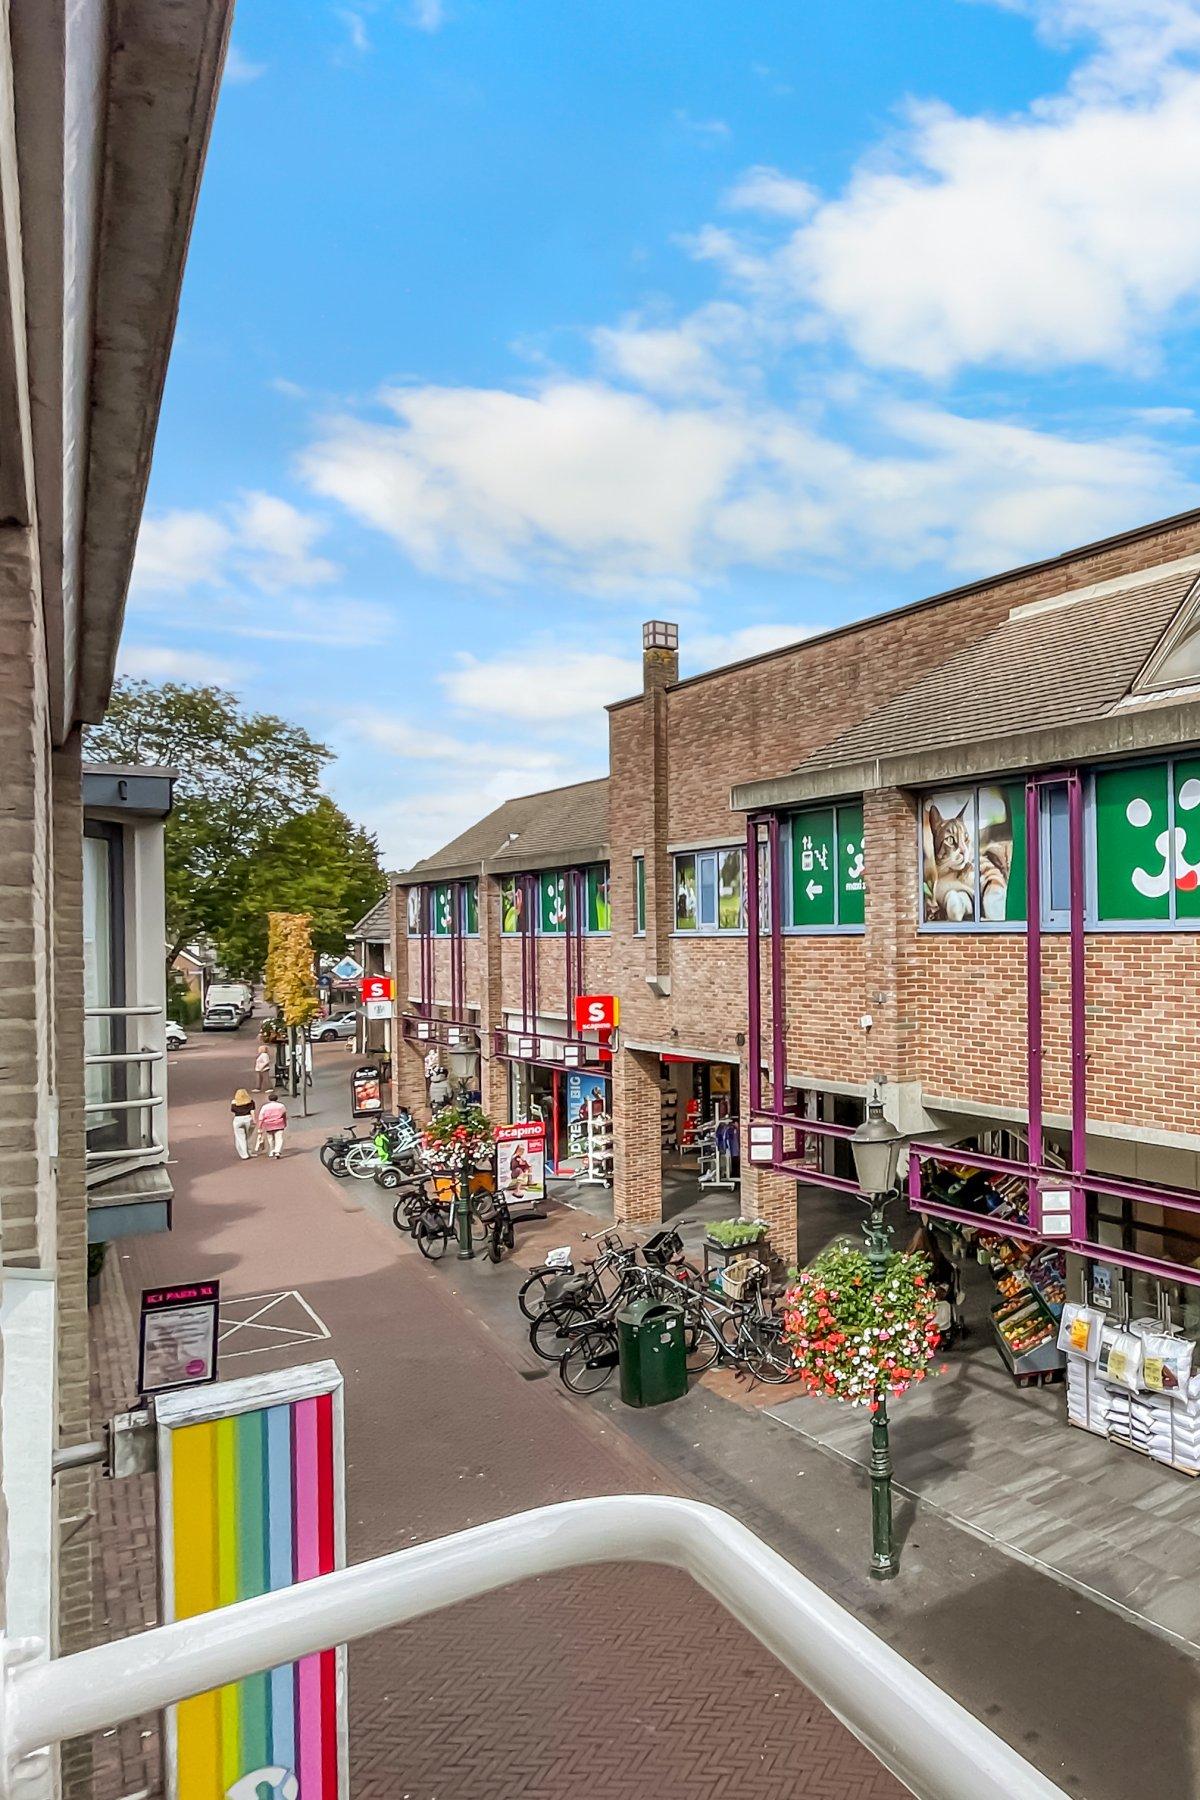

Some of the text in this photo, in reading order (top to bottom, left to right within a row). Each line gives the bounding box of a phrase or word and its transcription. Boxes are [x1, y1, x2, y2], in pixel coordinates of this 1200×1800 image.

[371, 983, 384, 997] S
[588, 1002, 606, 1022] S
[570, 1076, 581, 1098] BIG
[498, 1126, 543, 1139] scapino
